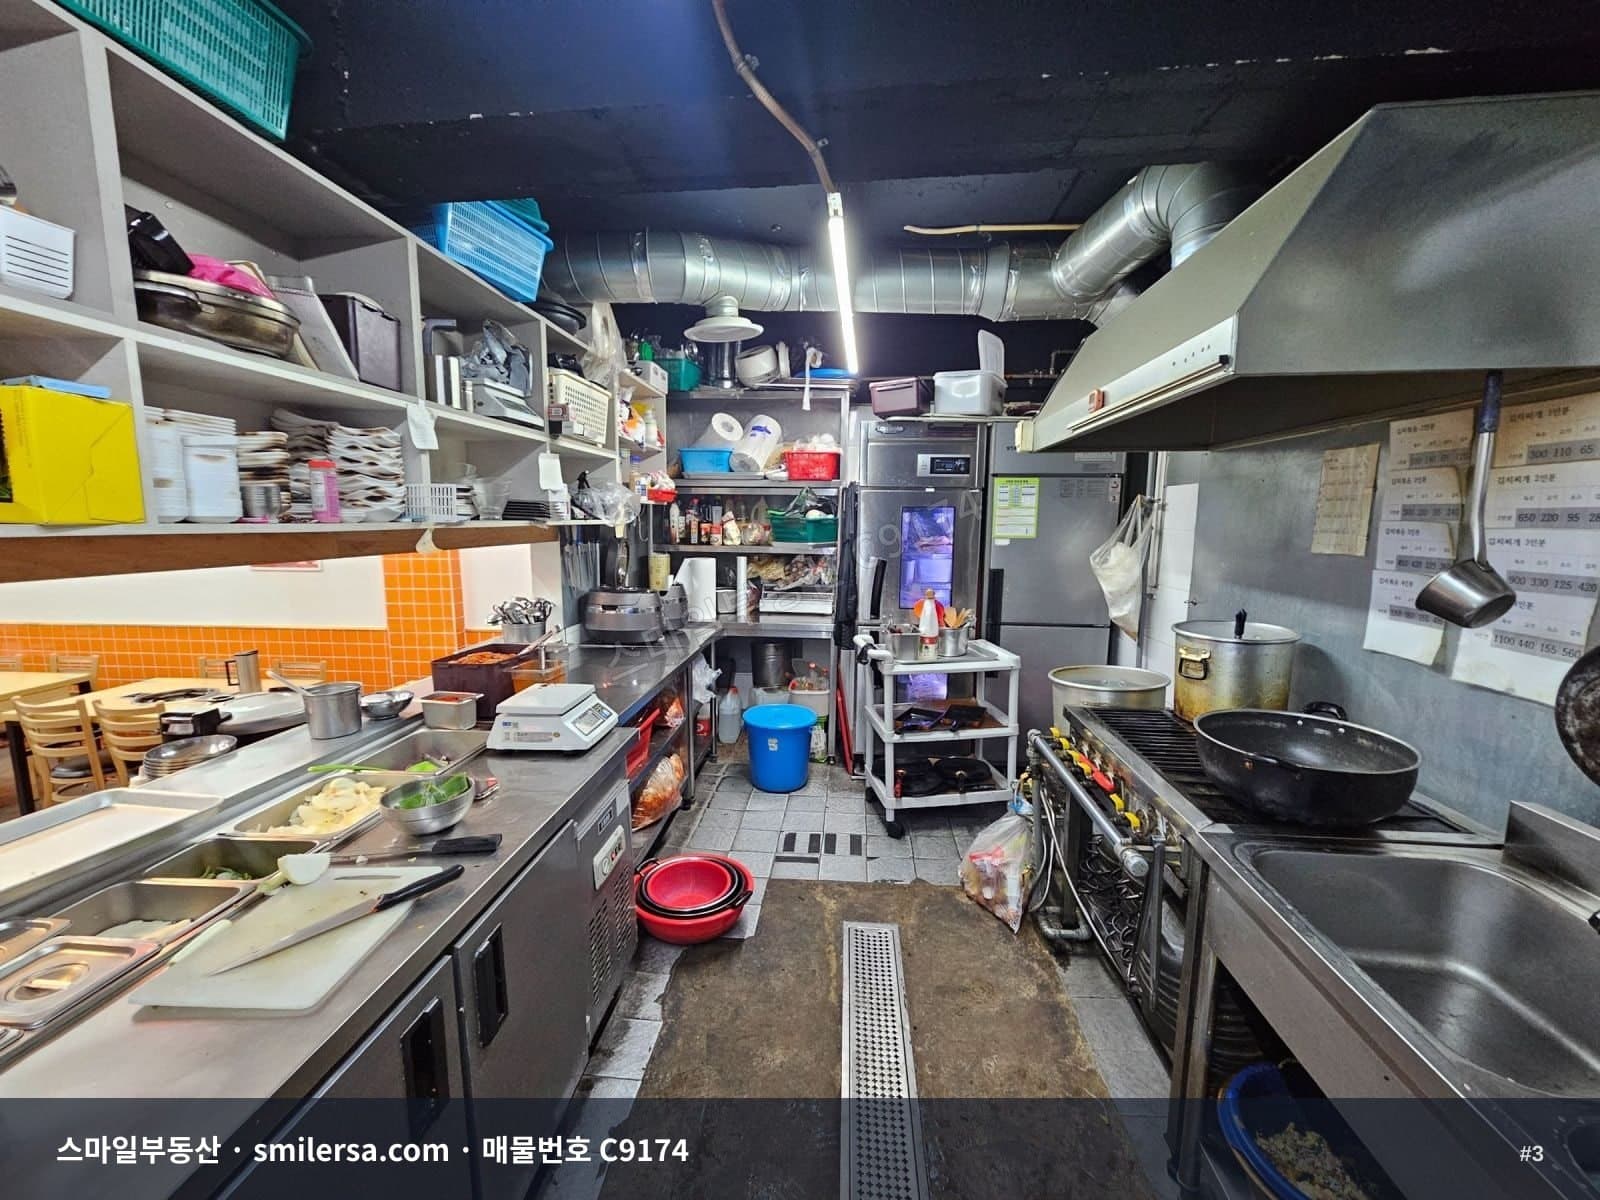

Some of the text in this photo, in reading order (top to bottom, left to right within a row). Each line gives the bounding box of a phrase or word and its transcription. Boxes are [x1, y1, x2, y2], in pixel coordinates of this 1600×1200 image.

[1553, 446, 1572, 458] 110
[1554, 580, 1573, 590] 125
[1578, 582, 1598, 593] 420
[1494, 634, 1515, 646] 1100
[1540, 642, 1558, 654] 155
